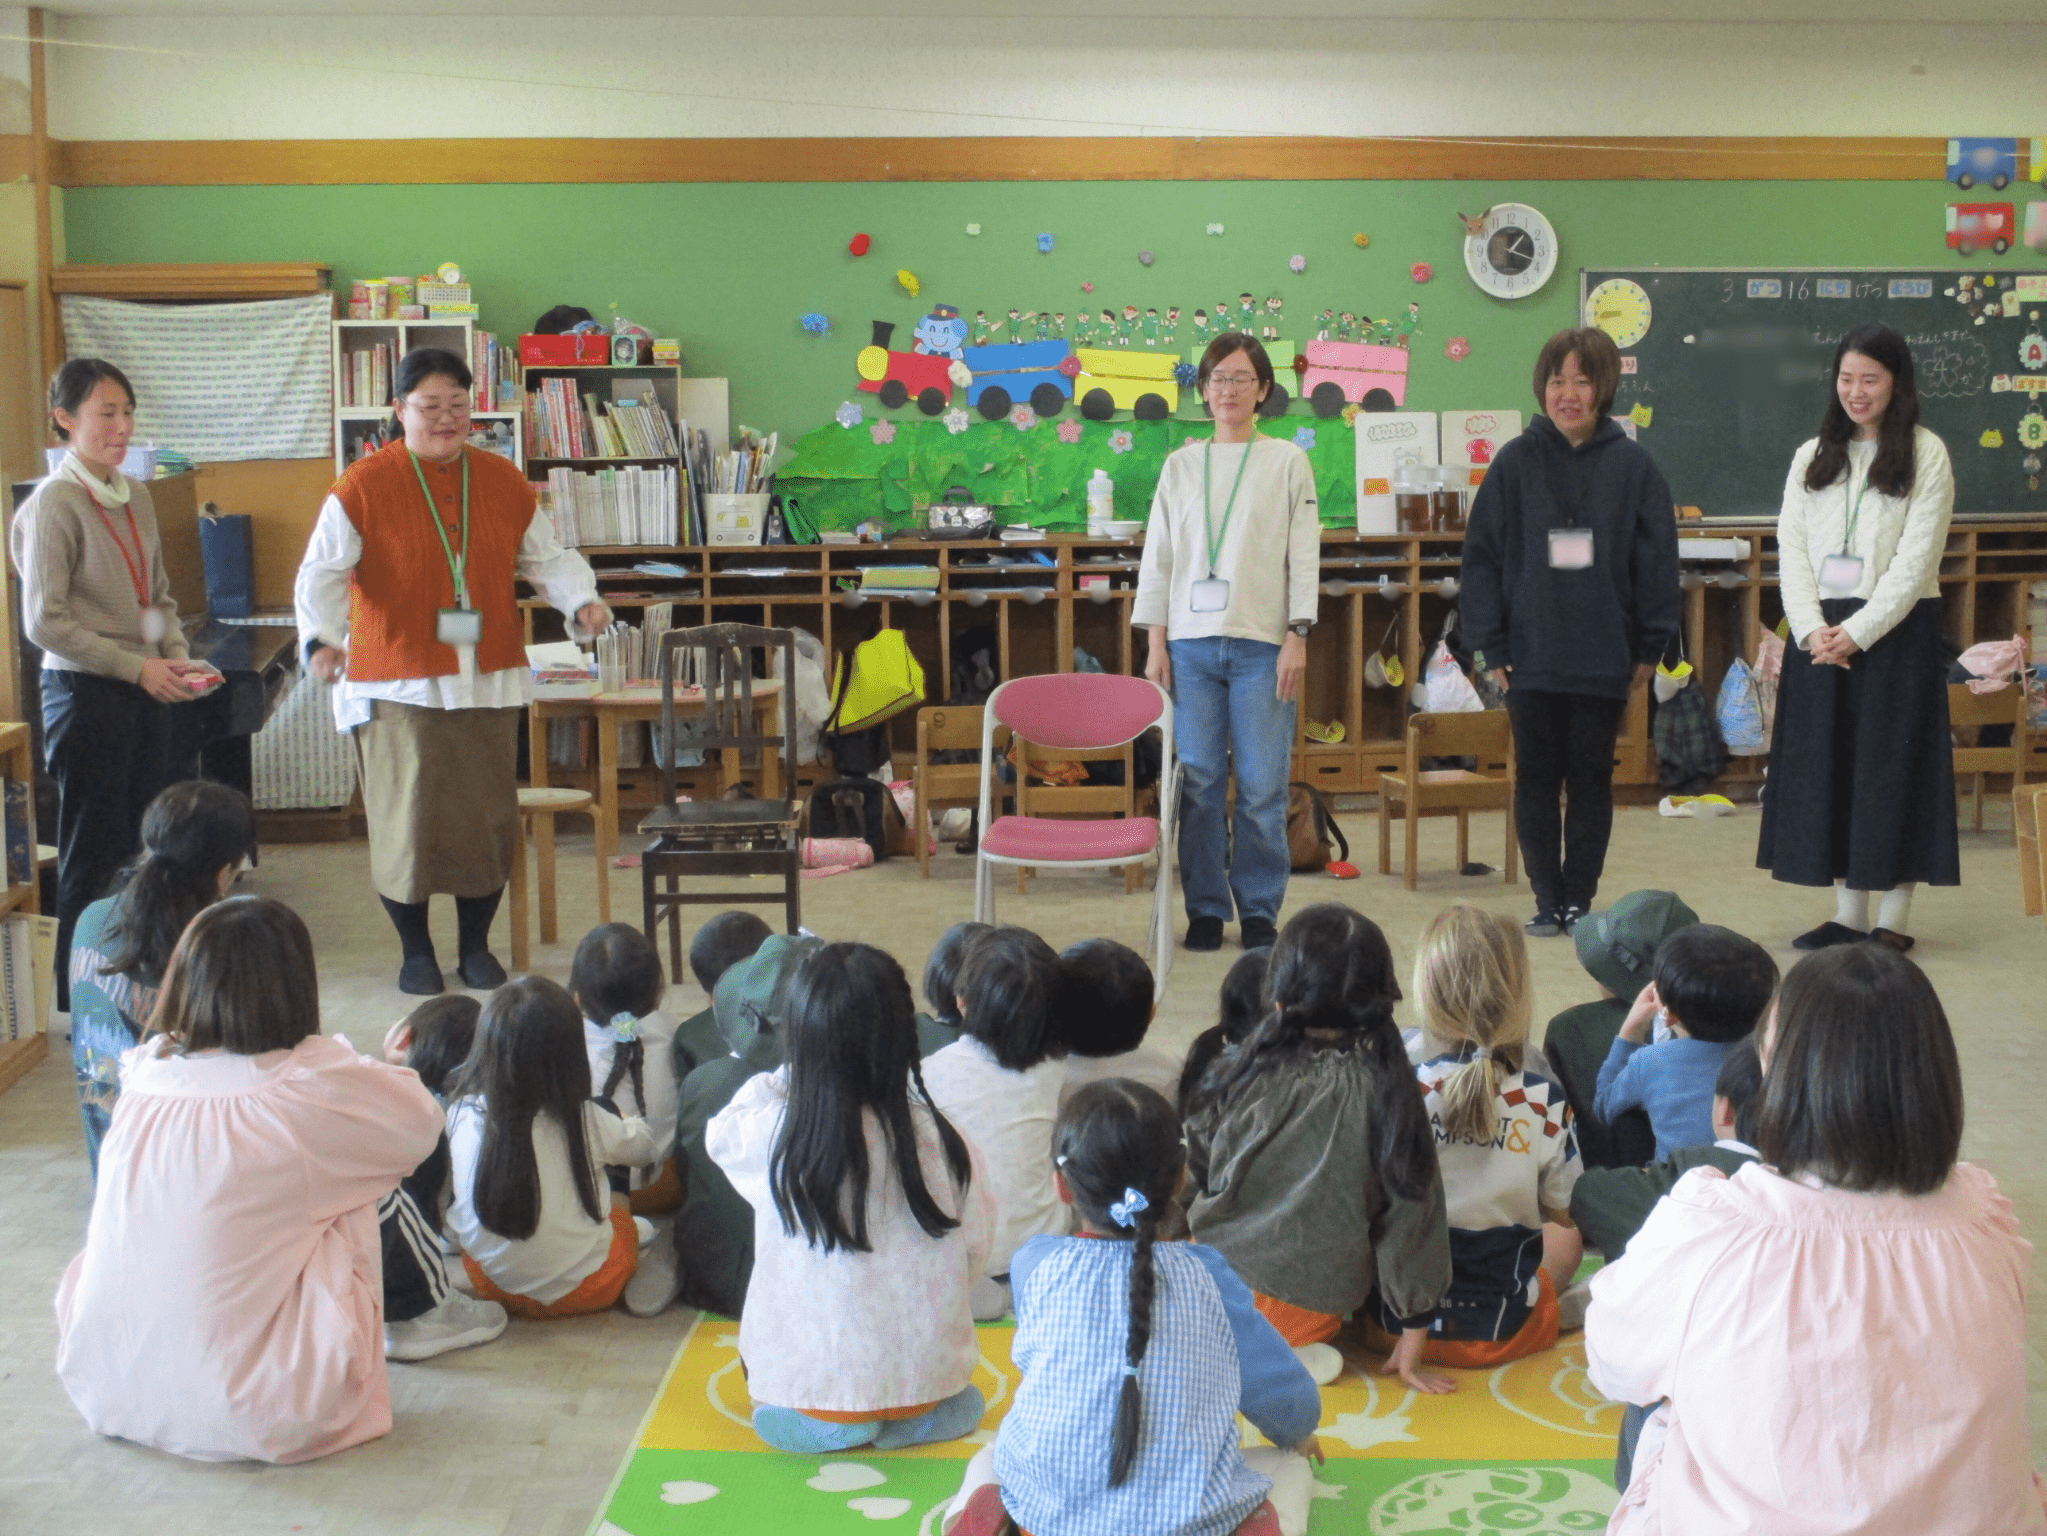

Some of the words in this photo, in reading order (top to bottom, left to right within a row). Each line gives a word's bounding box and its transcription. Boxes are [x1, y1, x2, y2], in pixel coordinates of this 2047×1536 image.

[1492, 218, 1500, 229] 11
[1507, 213, 1516, 225] 12
[1534, 229, 1541, 241] 2
[1476, 245, 1484, 258] 9
[1538, 245, 1545, 258] 3
[1480, 262, 1488, 274] 8
[1533, 262, 1541, 273] 4
[1492, 273, 1498, 285] 7
[1507, 277, 1514, 289] 6
[1522, 273, 1530, 285] 5
[1722, 278, 1734, 303] 3
[1789, 278, 1809, 301] 16
[2028, 344, 2042, 361] A
[2028, 422, 2042, 441] B
